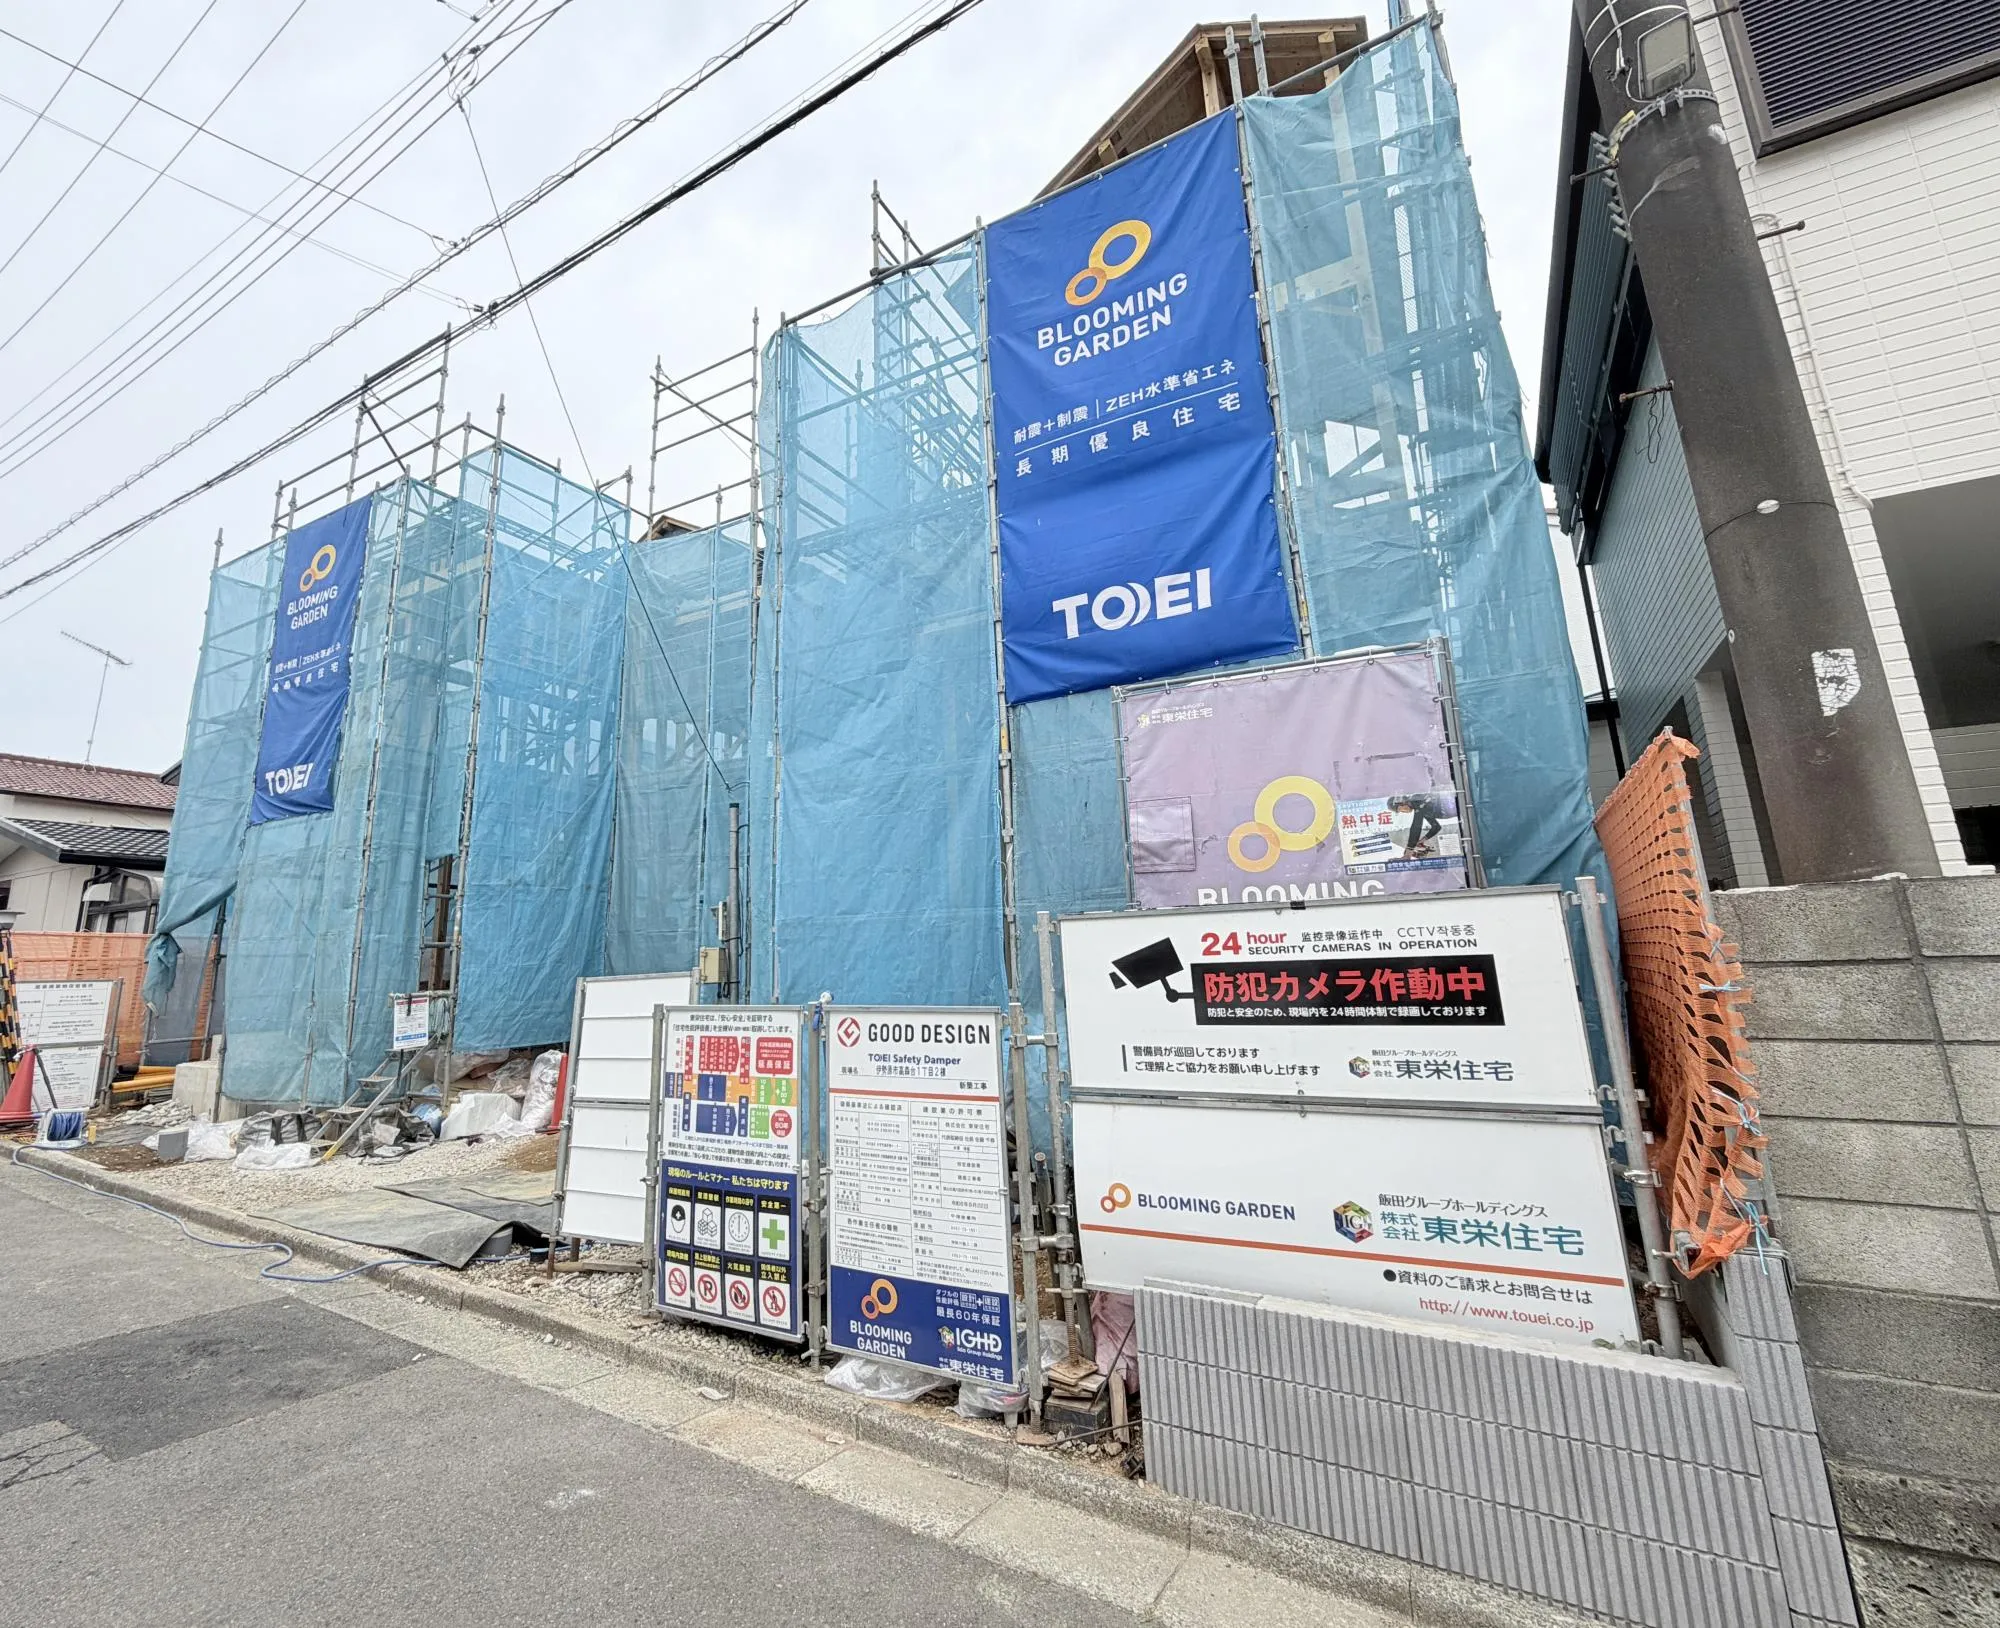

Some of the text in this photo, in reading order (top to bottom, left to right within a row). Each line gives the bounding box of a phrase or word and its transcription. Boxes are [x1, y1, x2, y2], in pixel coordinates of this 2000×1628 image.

[1037, 273, 1188, 350] BLOOMING
[1054, 309, 1172, 367] GARDEN
[1014, 359, 1236, 444] 耐震+制震 ZEH水準省エネ
[1016, 392, 1241, 478] 長期優良住宅
[287, 585, 338, 616] BLOOMING
[1052, 568, 1212, 640] TOEI
[291, 604, 328, 630] GARDEN
[1162, 707, 1213, 723] 東栄住宅
[265, 763, 314, 796] TOEI
[1341, 811, 1394, 829] 熱中症
[1301, 929, 1383, 942] 监控录像运作中
[1397, 924, 1476, 938] CCTV작동중
[1201, 932, 1287, 956] 24 hour
[1248, 938, 1477, 955] SECURITY CAMERAS IN OPERATION
[1204, 966, 1486, 1004] 防犯カメラ作動中
[1207, 1006, 1488, 1018] 防犯と安全のため、現場内を24時間体制で録画しております
[869, 1023, 990, 1044] GOOD DESIGN
[868, 1054, 961, 1066] TOEI Safety Damper
[1133, 1046, 1259, 1058] 警備員が巡回しております
[1135, 1062, 1320, 1076] ご理解とご協力をお願い申し上げます
[1394, 1059, 1514, 1082] 東栄住宅
[668, 1166, 789, 1191] 現場のルールとマナー 私たちは守ります
[1138, 1193, 1295, 1220] BLOOMING GARDEN
[1379, 1193, 1548, 1218] 飯田グループホールディングス
[1380, 1211, 1418, 1226] 株式
[1383, 1226, 1420, 1241] 会社
[1420, 1216, 1584, 1256] 東栄住宅
[761, 1271, 786, 1282] 立入禁止
[1398, 1269, 1592, 1304] 資料のご請求とお問合せは
[936, 1289, 958, 1297] ダブルの
[961, 1294, 999, 1306] 設計 建設
[936, 1309, 1000, 1327] 最長60年保証
[1419, 1298, 1594, 1333] http://www.touei.co.jp
[850, 1320, 912, 1345] BLOOMING
[956, 1327, 1002, 1353] IGHD
[857, 1336, 906, 1359] GARDEN
[950, 1358, 1004, 1381] 東栄住宅
